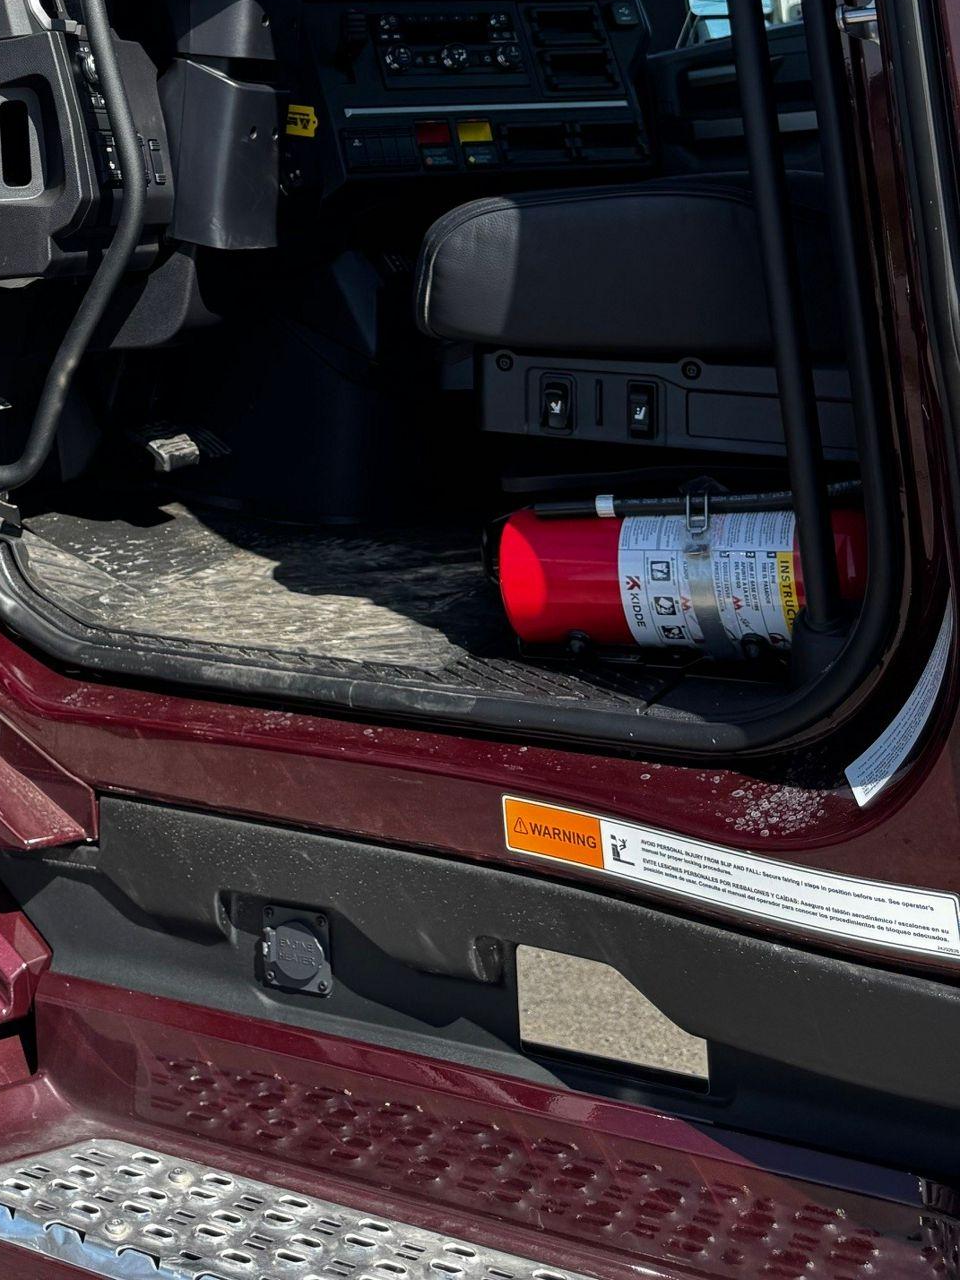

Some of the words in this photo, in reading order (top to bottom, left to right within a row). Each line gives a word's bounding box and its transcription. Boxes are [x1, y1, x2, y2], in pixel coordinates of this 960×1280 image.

[630, 593, 646, 627] KIDDE
[529, 822, 597, 849] WARNING
[657, 844, 684, 855] PERSONAL
[685, 851, 703, 860] INJURY
[704, 856, 719, 864] FROM
[746, 867, 761, 875] FALL:
[762, 872, 781, 880] Secure
[828, 887, 852, 896] position
[853, 892, 872, 900] before
[902, 902, 934, 911] operator's
[668, 854, 682, 862] proper
[703, 863, 732, 875] procedures.
[684, 869, 718, 883] PERSONALES
[720, 879, 731, 887] POR
[830, 915, 875, 929] procedimientos
[913, 933, 949, 942] adecuados.
